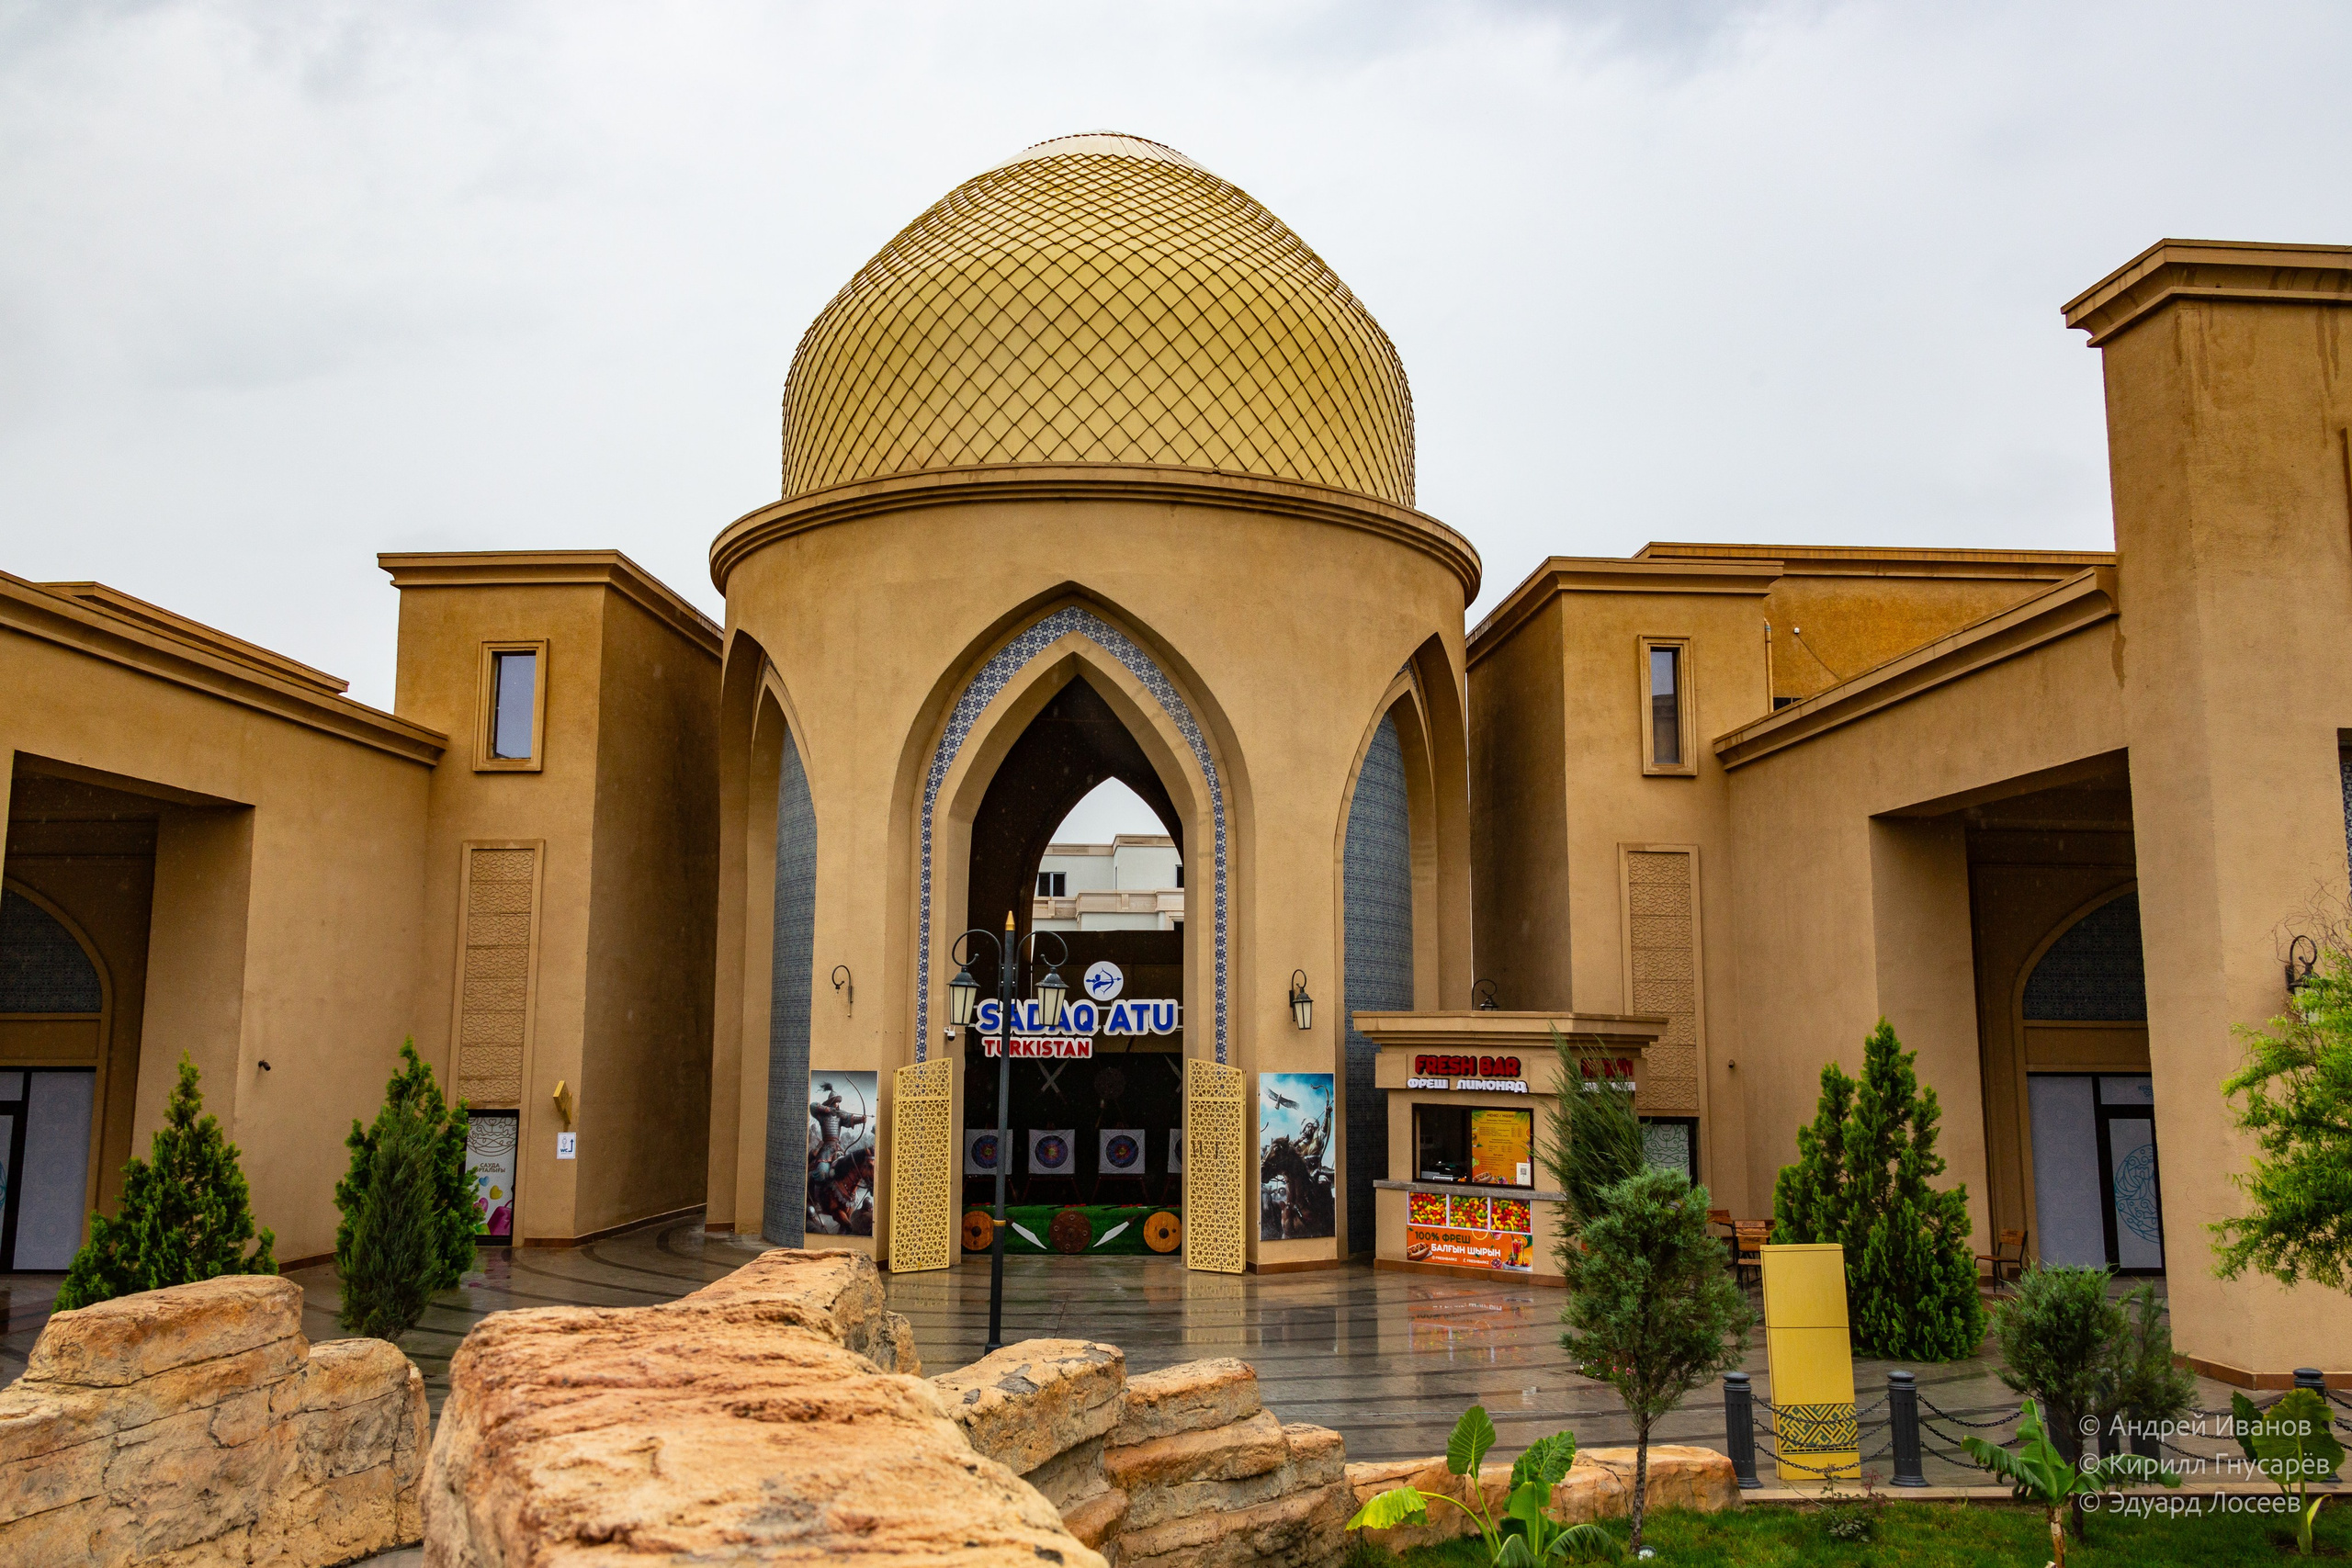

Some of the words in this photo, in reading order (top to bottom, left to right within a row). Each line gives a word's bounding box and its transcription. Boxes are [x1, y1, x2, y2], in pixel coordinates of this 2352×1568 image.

[1108, 1003, 1175, 1032] ATU
[1415, 1055, 1477, 1076] FRESH
[1478, 1055, 1521, 1077] BAR
[1407, 1077, 1450, 1089] ФРЕШ
[1456, 1078, 1529, 1093] ЛИМОНАД
[1415, 1231, 1440, 1242] 100%
[1442, 1233, 1471, 1244] ФРЕШ
[1430, 1243, 1466, 1256] БАЛҒЫН
[1466, 1246, 1501, 1258] ШЫРЫН
